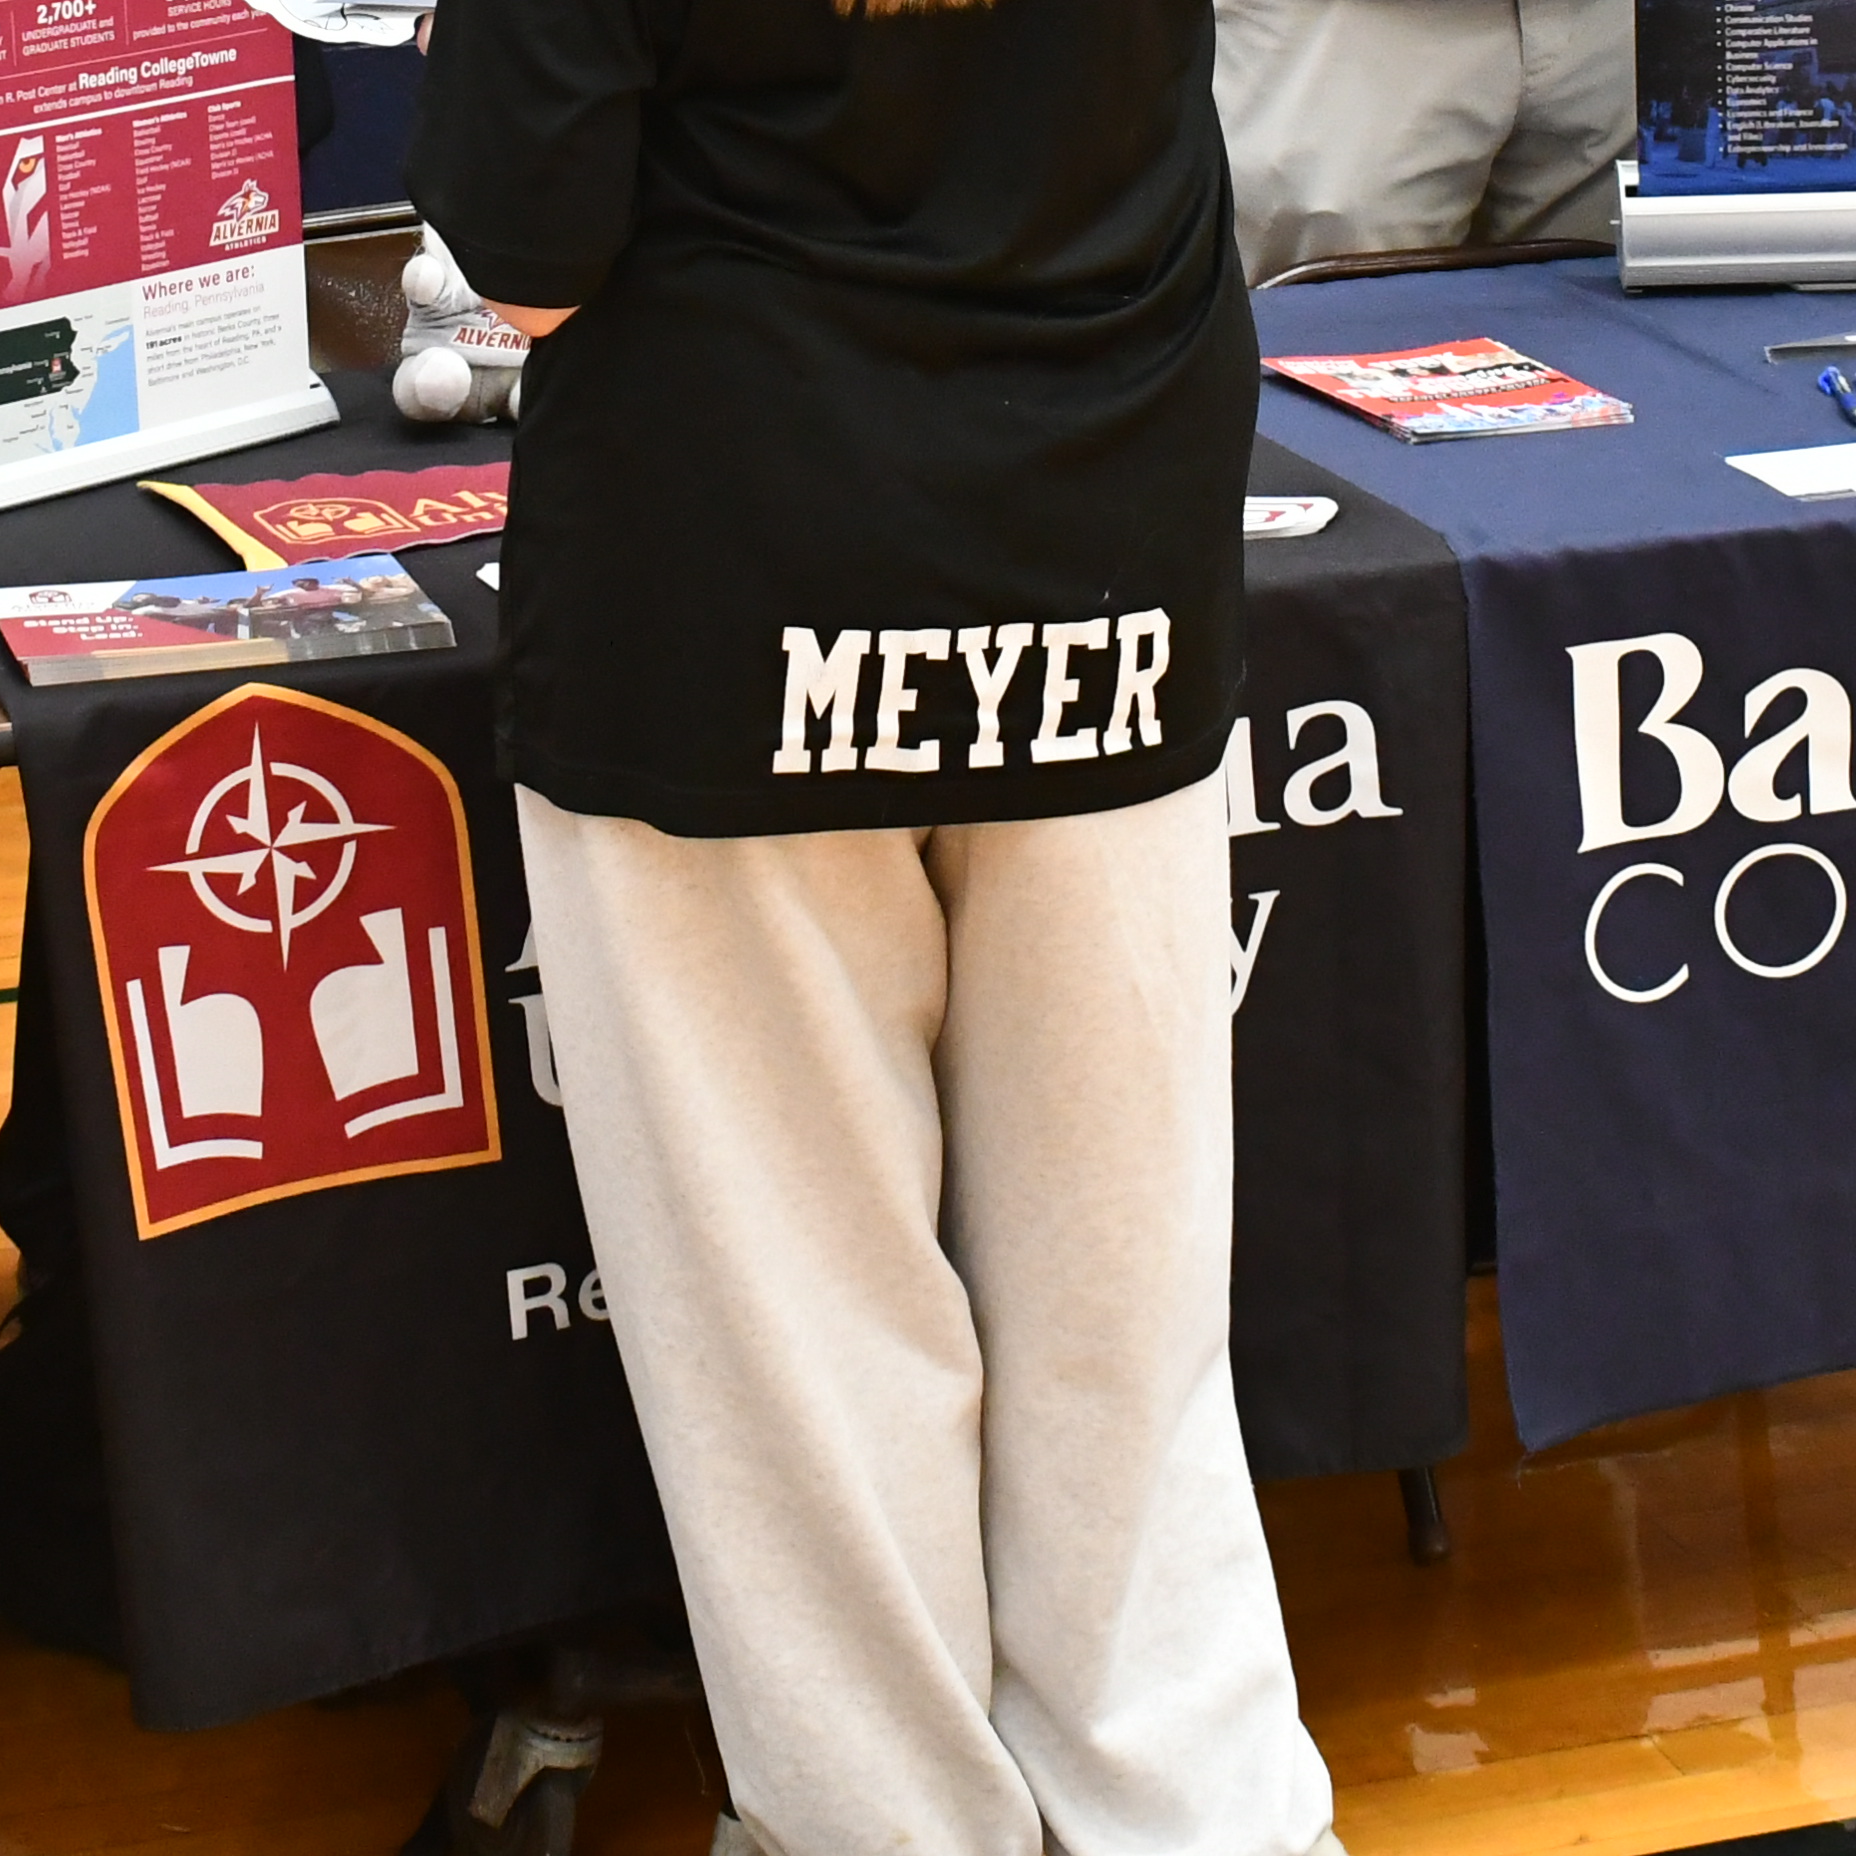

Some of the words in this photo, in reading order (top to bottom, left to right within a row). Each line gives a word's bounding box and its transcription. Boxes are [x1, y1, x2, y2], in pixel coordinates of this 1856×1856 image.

[79, 64, 137, 90] Reading
[141, 47, 237, 78] CollegeTowne
[213, 213, 277, 242] ALVERNIA
[142, 279, 193, 301] Where
[199, 273, 220, 288] we
[226, 265, 255, 283] are:
[771, 607, 1170, 776] MEYER
